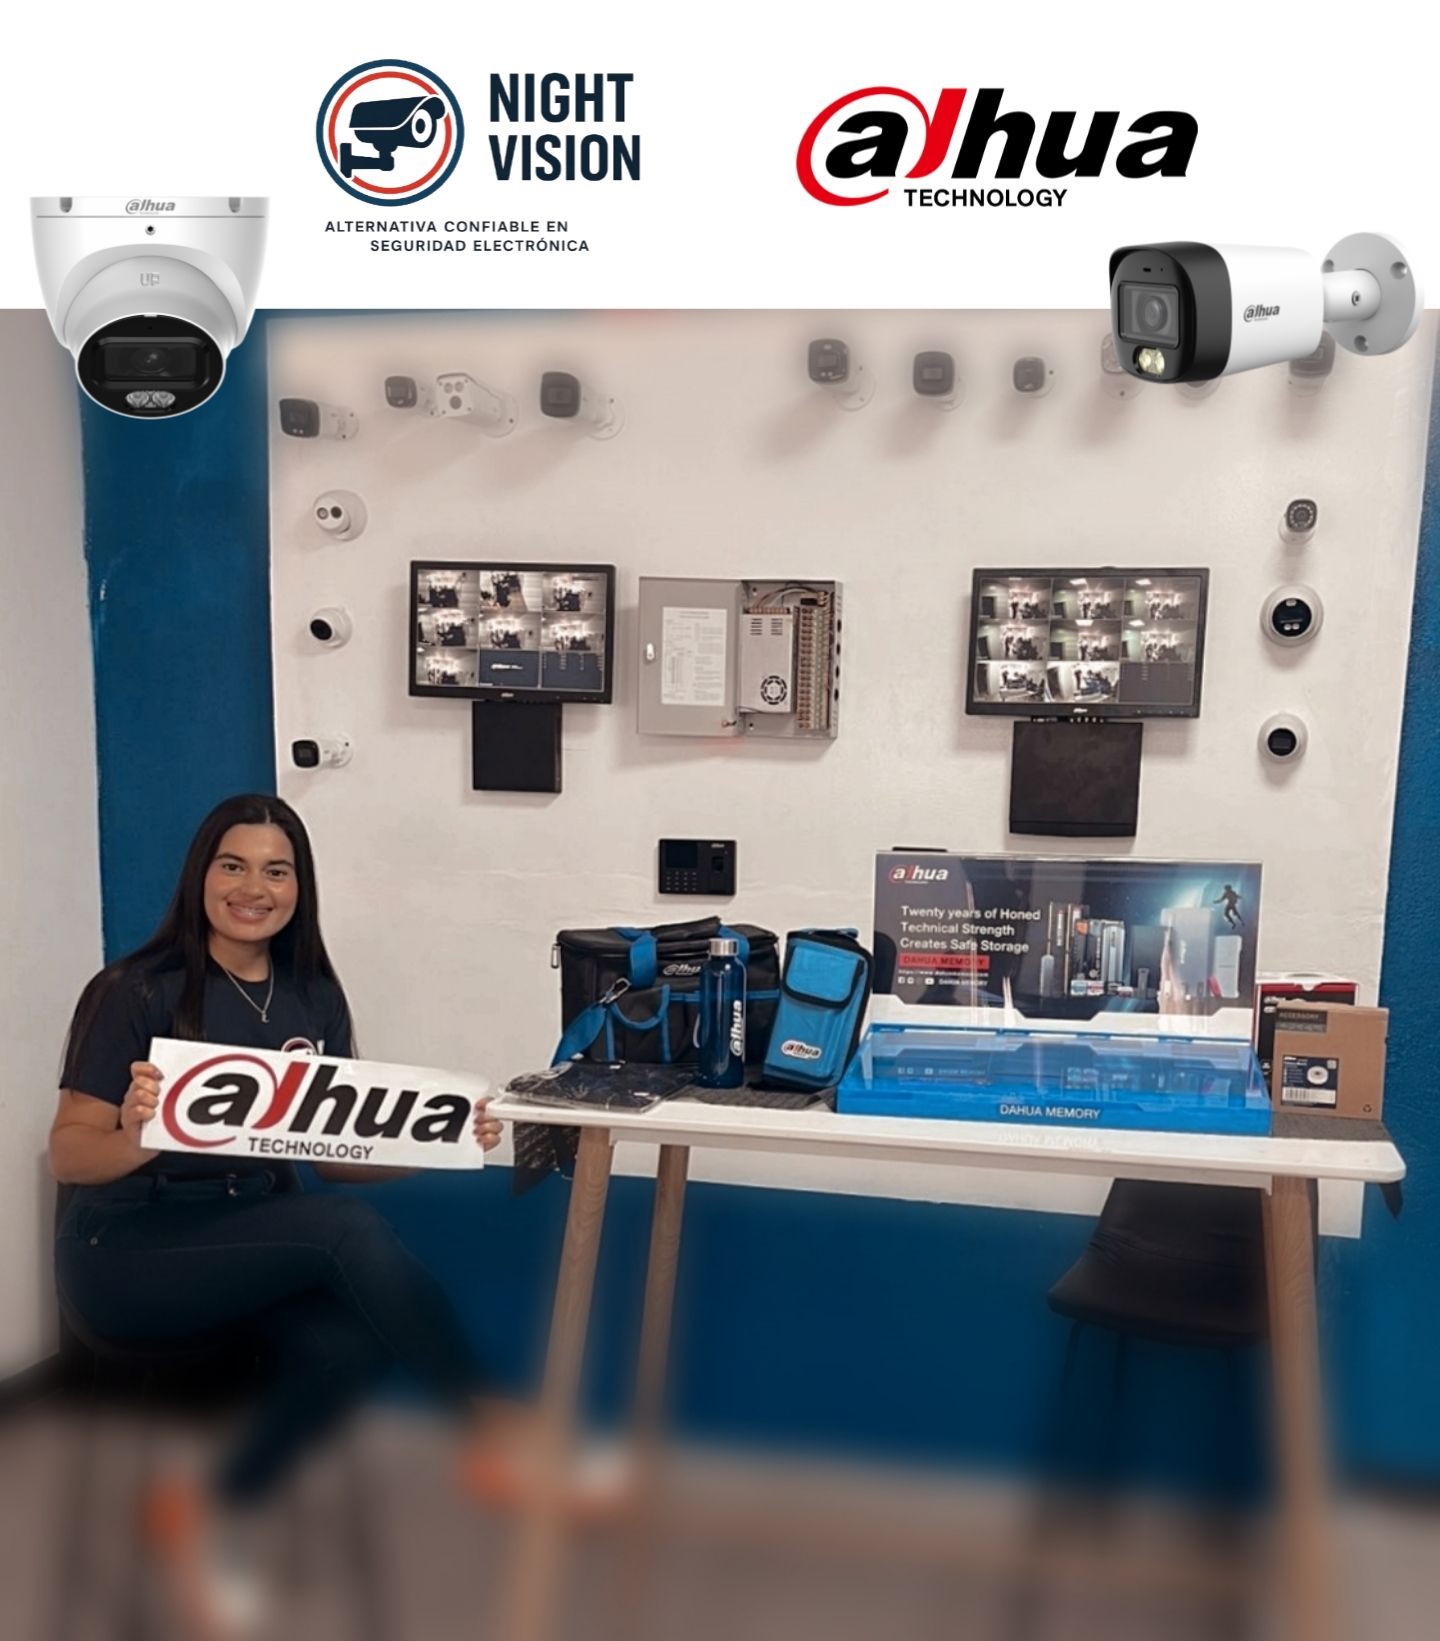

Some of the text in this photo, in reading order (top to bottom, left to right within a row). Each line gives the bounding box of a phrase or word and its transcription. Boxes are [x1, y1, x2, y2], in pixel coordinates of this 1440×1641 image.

[901, 906, 1041, 920] Twenty years of Honed
[901, 922, 1015, 938] Technical Strength
[900, 938, 1030, 954] Creates Safe Storage
[1000, 1104, 1100, 1119] DAHUA MEMORY
[248, 1136, 374, 1161] TECHNOLOGY
